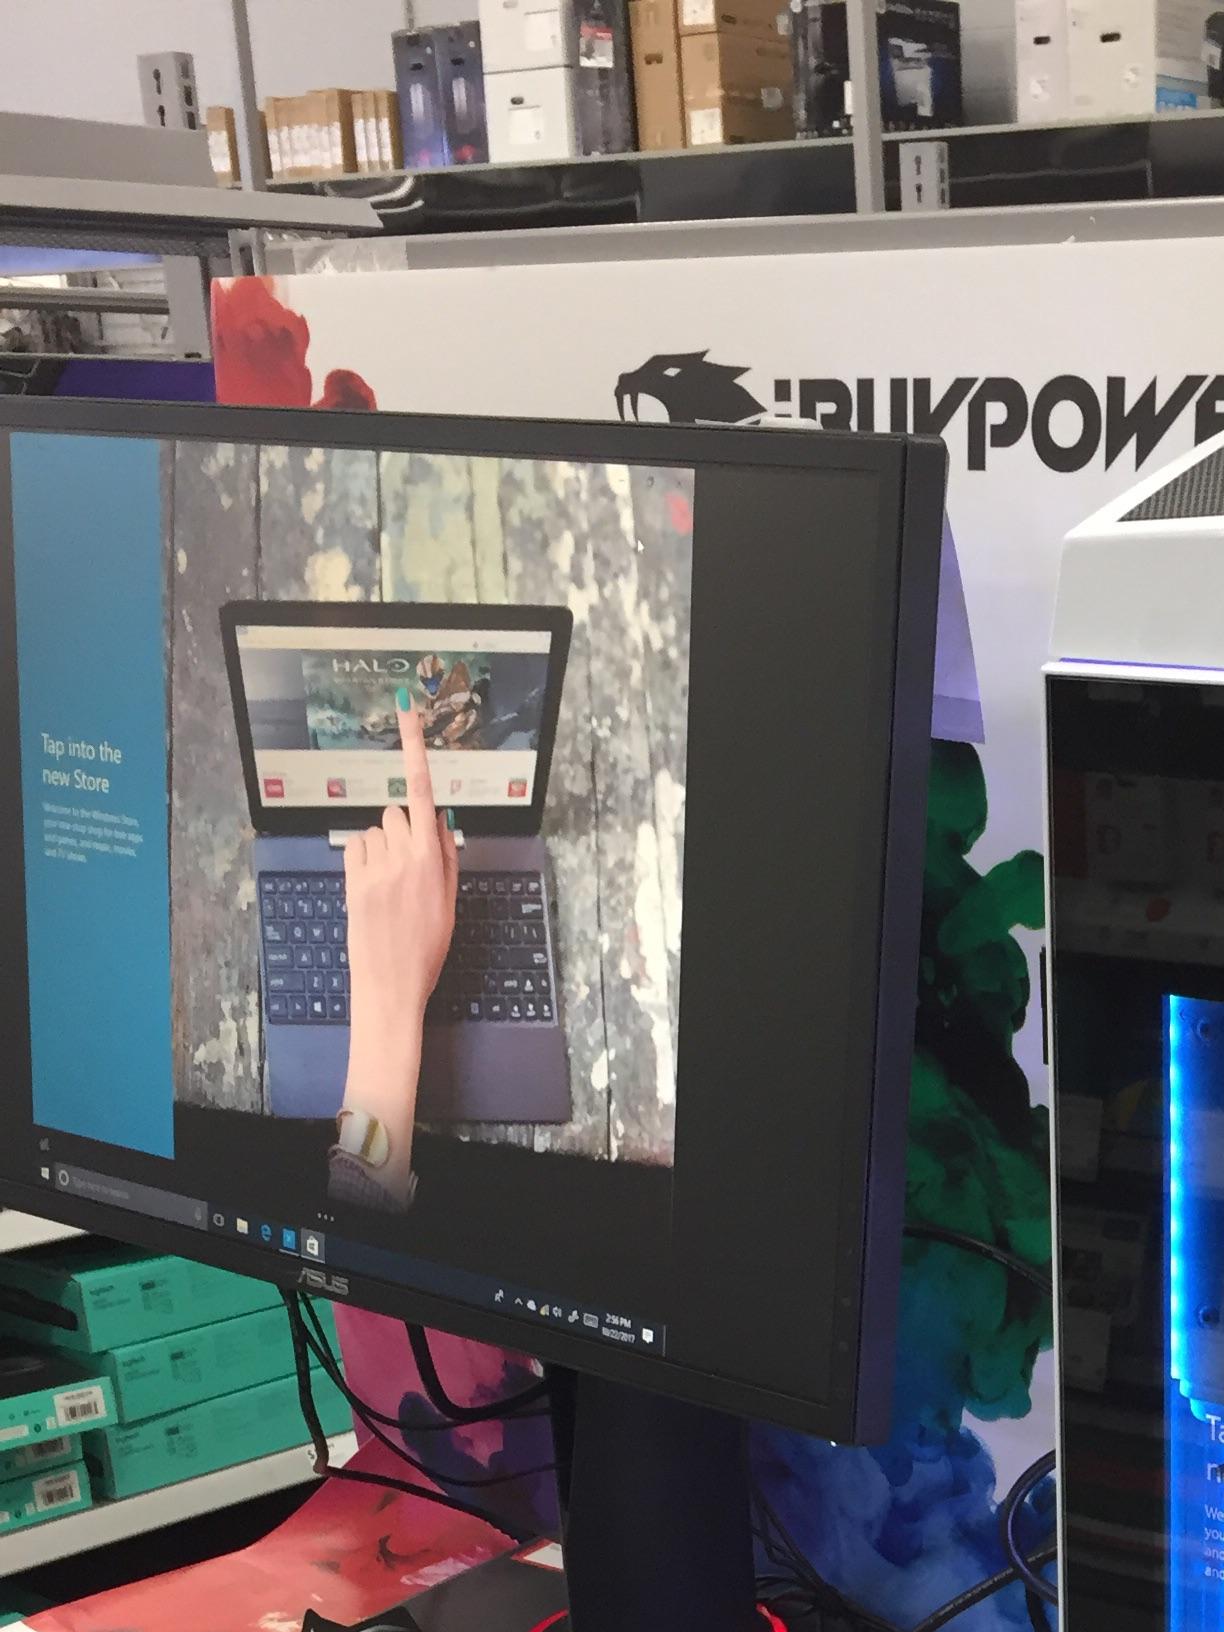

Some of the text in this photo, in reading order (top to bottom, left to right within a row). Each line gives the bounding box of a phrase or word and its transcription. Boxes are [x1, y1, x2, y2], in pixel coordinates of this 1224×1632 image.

[40, 732, 122, 765] Tap into the
[42, 767, 110, 794] new Store
